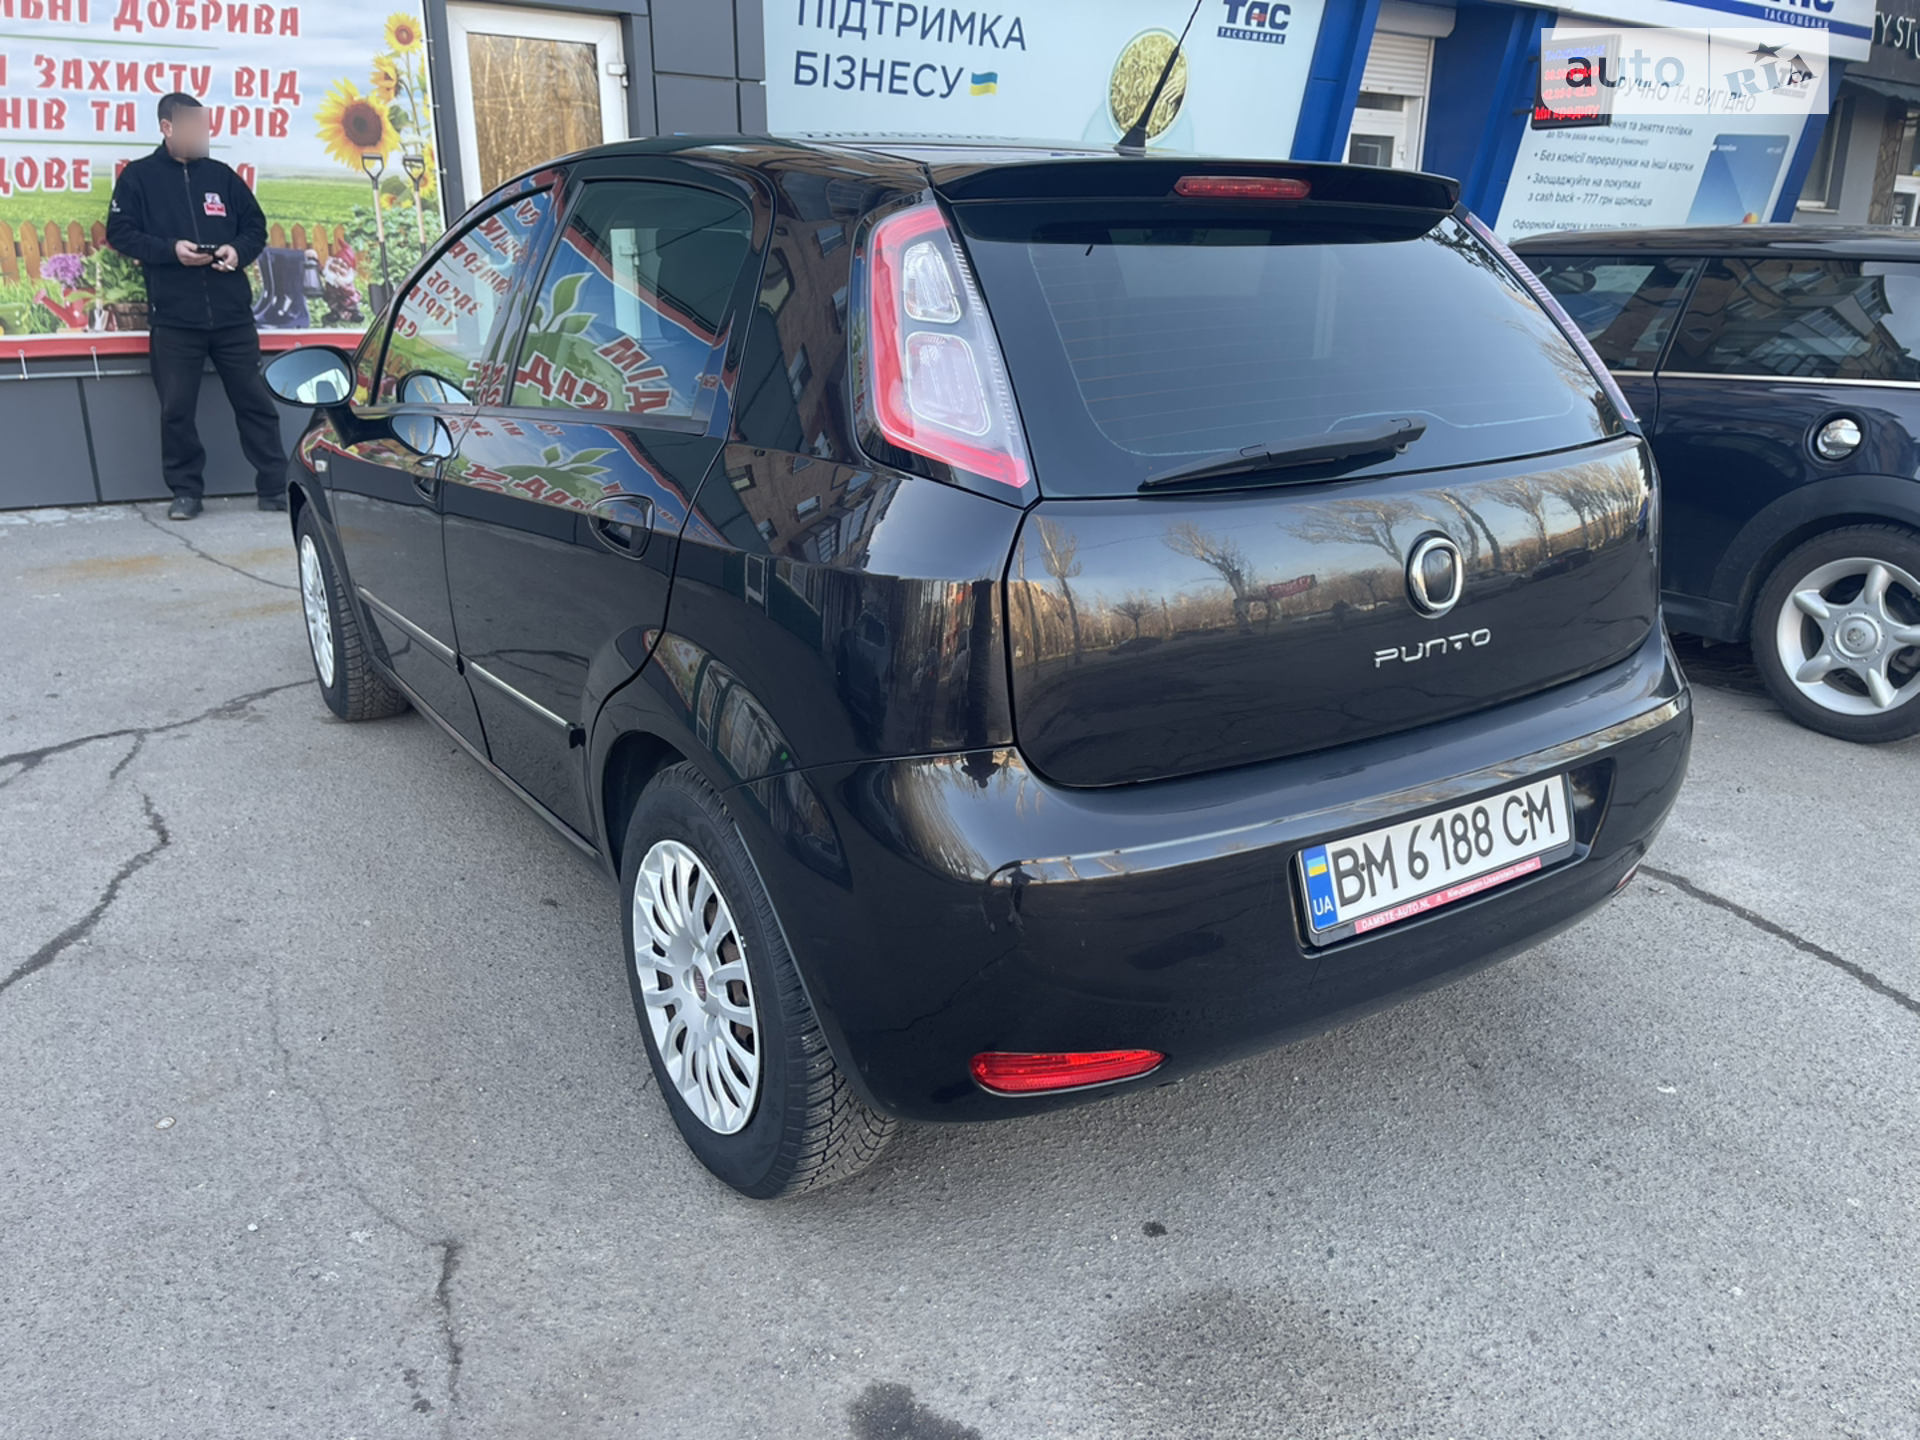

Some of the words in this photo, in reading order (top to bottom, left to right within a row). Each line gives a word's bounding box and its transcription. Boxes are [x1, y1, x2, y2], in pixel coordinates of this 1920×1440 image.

[114, 0, 299, 37] ДОБРИВА
[798, 0, 1027, 51] ПІДТРИМКА
[34, 54, 211, 97] ЗАХИСТУ
[235, 67, 300, 105] ВІД
[794, 50, 964, 99] БІЗНЕСУ
[0, 97, 67, 130] НІВ
[91, 100, 136, 132] ТА
[208, 104, 289, 138] УРІВ
[1540, 149, 1556, 162] Без
[1535, 190, 1554, 203] cash
[1555, 191, 1574, 203] back
[1582, 193, 1599, 204] 777
[1592, 178, 1602, 188] на
[1374, 628, 1491, 668] PUNTO
[1313, 894, 1335, 916] UA
[1331, 834, 1399, 908] BM
[1407, 806, 1494, 880] 6188
[1502, 784, 1555, 846] CM
